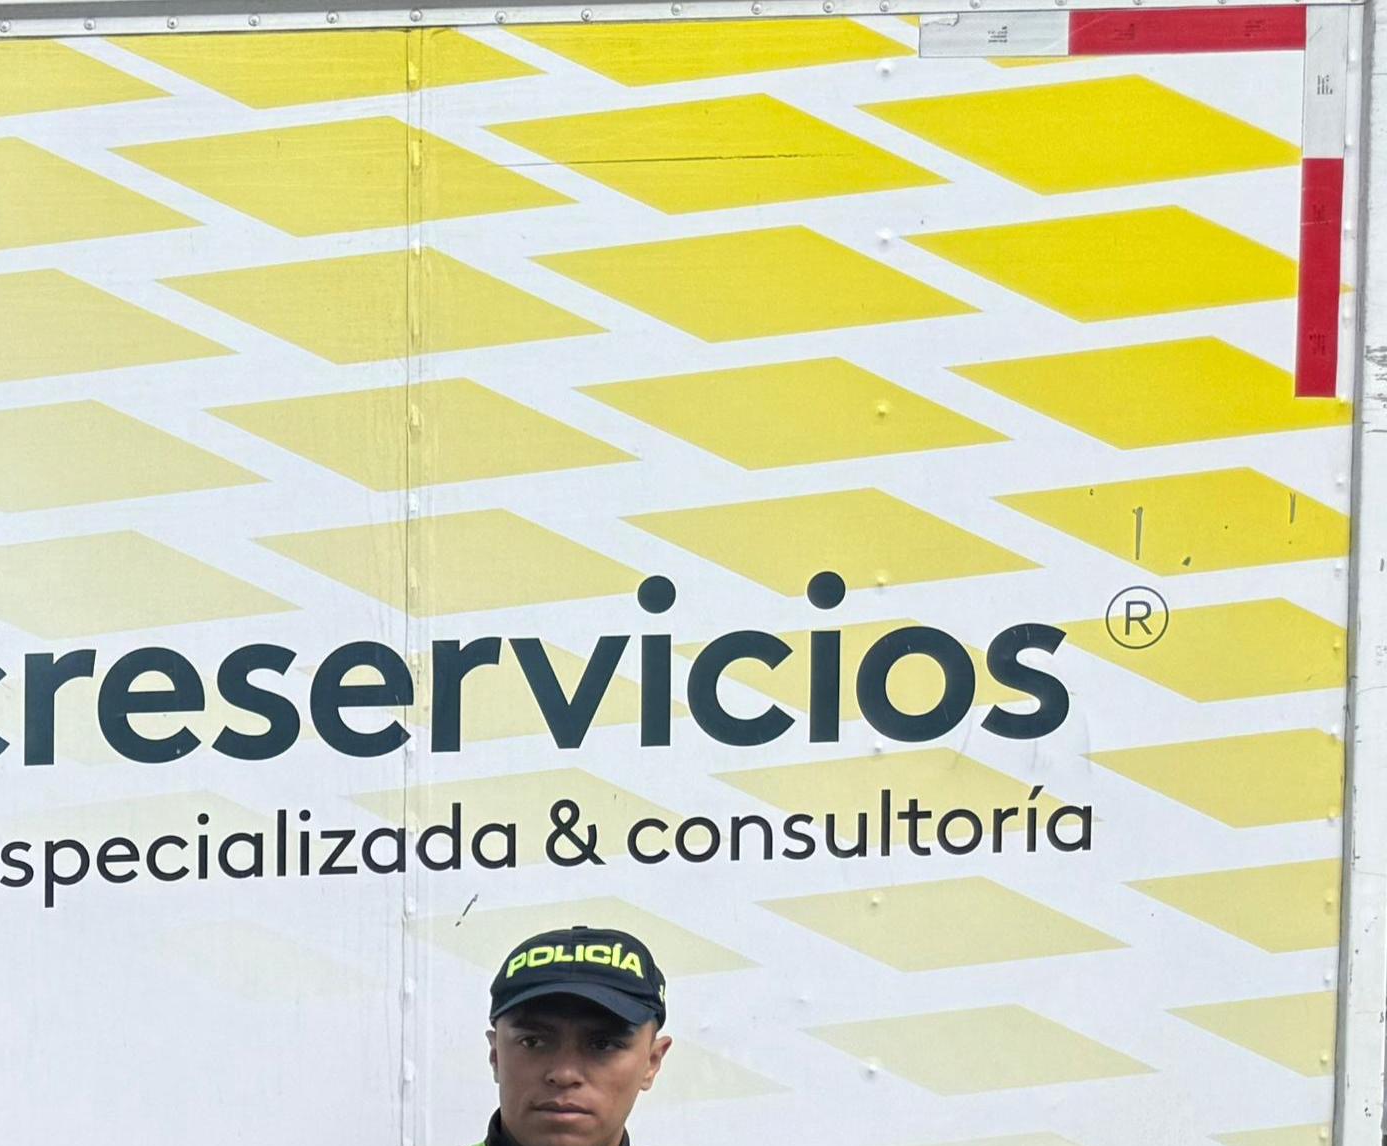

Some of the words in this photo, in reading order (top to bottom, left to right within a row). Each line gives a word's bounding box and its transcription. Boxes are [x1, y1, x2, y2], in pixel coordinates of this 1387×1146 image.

[544, 799, 607, 867] &
[626, 785, 1093, 861] consultoría
[505, 943, 644, 979] POLICÍA
